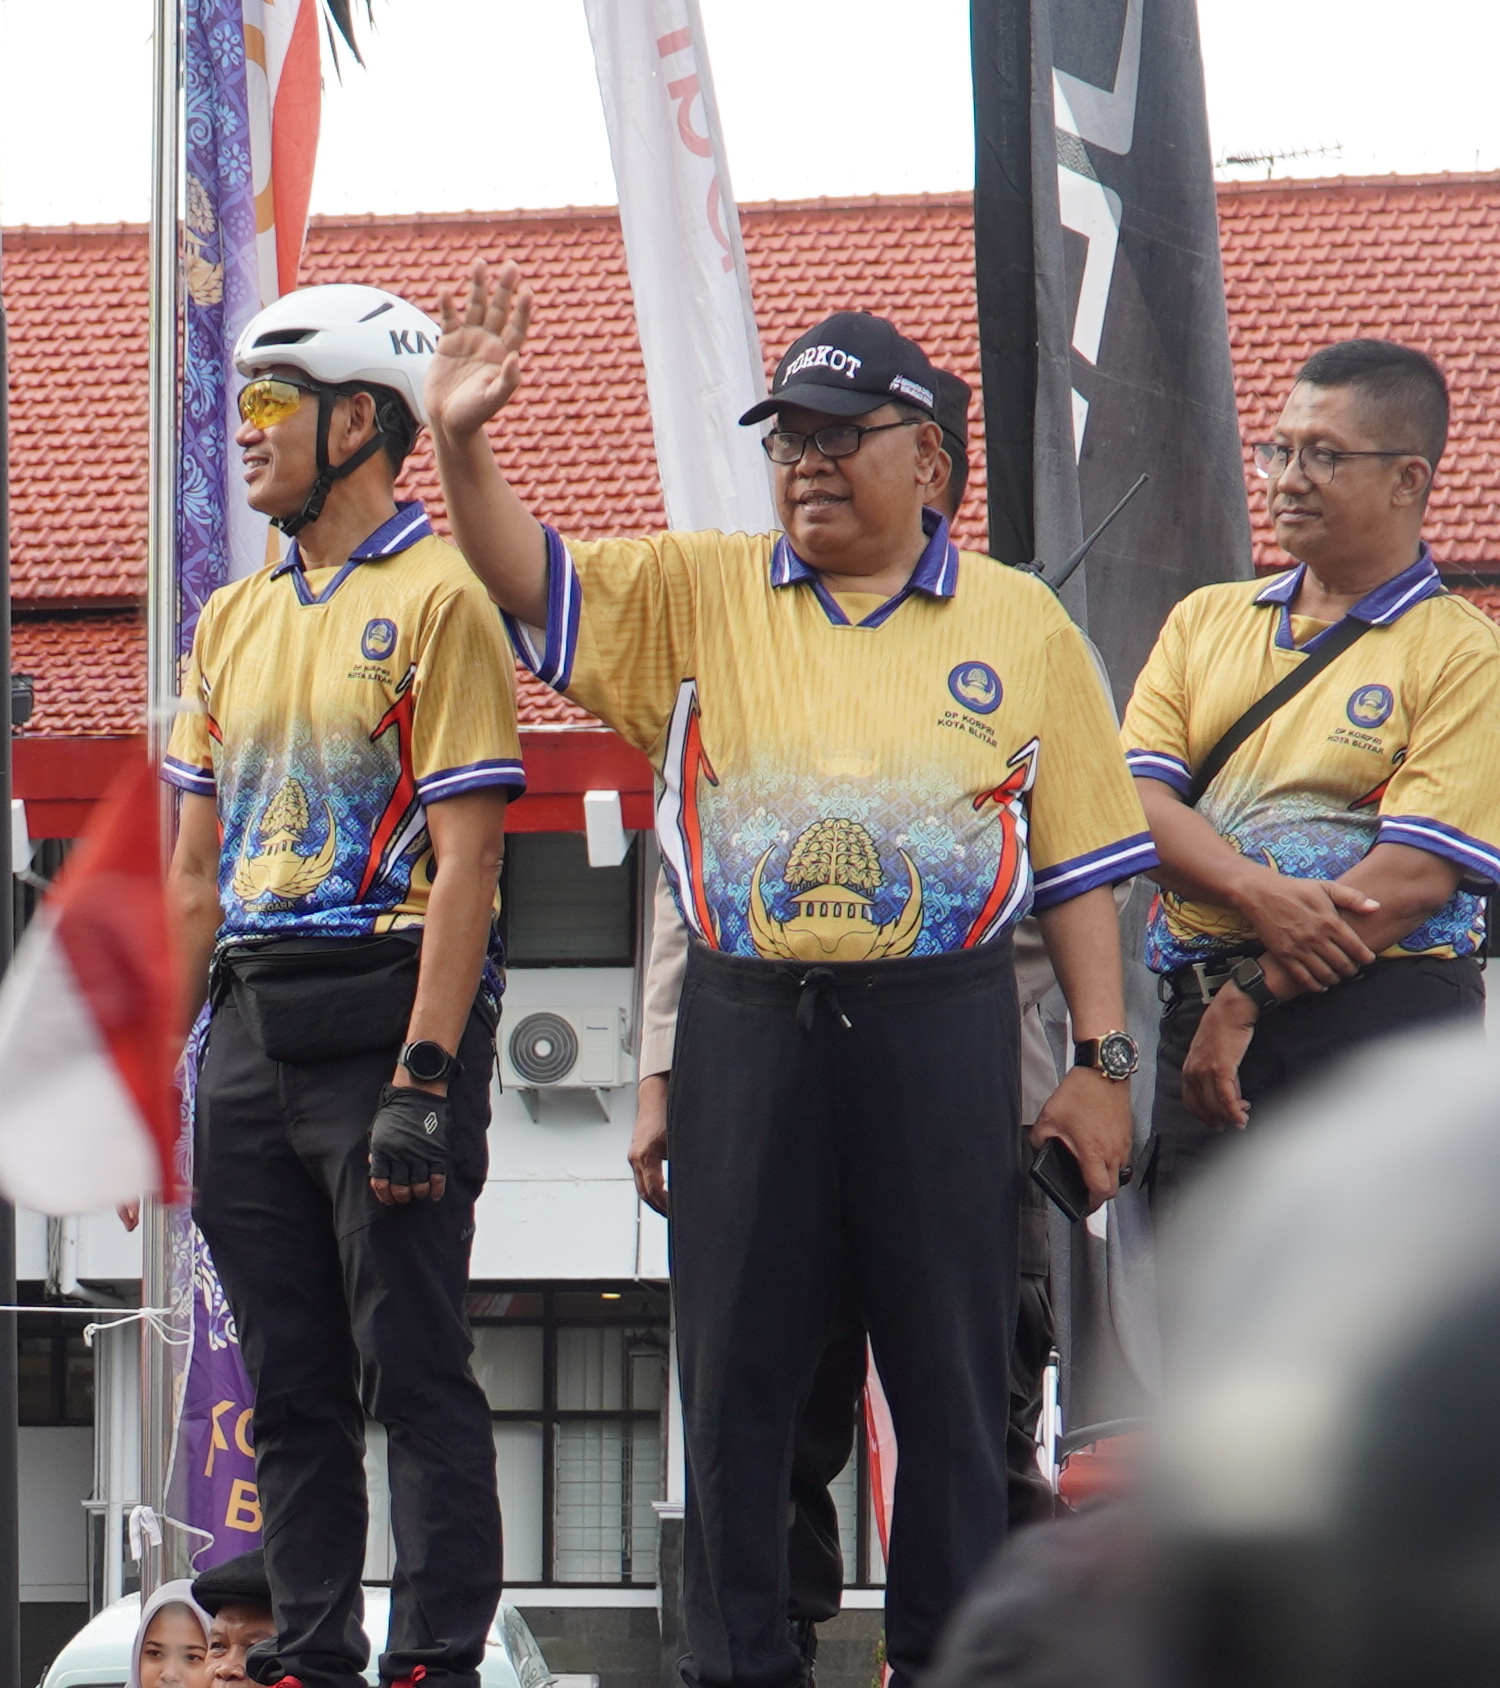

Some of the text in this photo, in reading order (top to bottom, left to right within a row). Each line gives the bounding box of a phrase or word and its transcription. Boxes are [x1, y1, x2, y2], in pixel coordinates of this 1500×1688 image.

[781, 344, 862, 387] FORKOT
[937, 718, 998, 749] KOTA BLITAR
[944, 711, 996, 737] DP KORPRI
